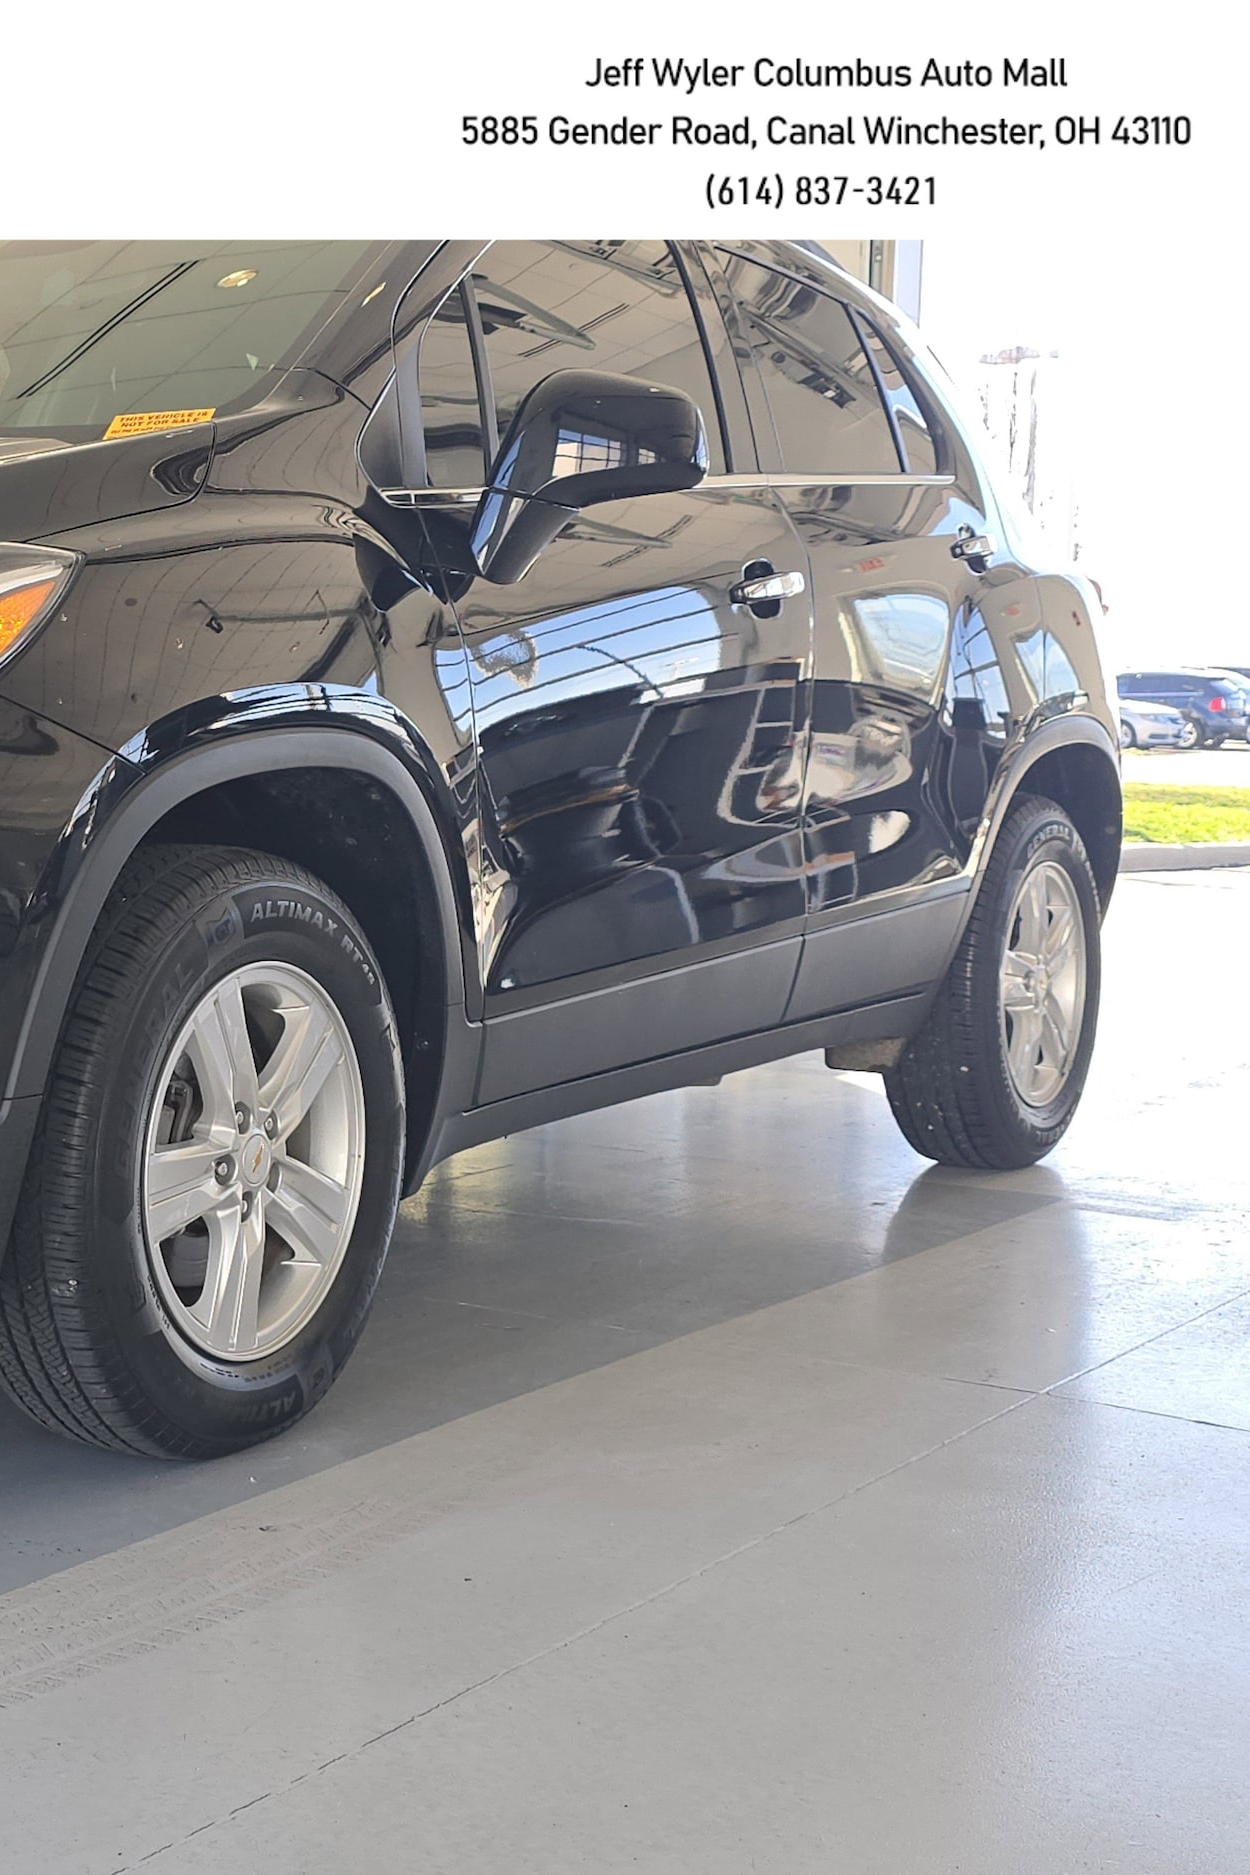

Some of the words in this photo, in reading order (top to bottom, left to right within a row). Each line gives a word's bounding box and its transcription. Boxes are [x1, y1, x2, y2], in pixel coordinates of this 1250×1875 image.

[119, 415, 145, 423] THIS
[148, 411, 193, 421] VEHICLE
[146, 418, 169, 426] FOR
[250, 900, 339, 938] ALTIMAX
